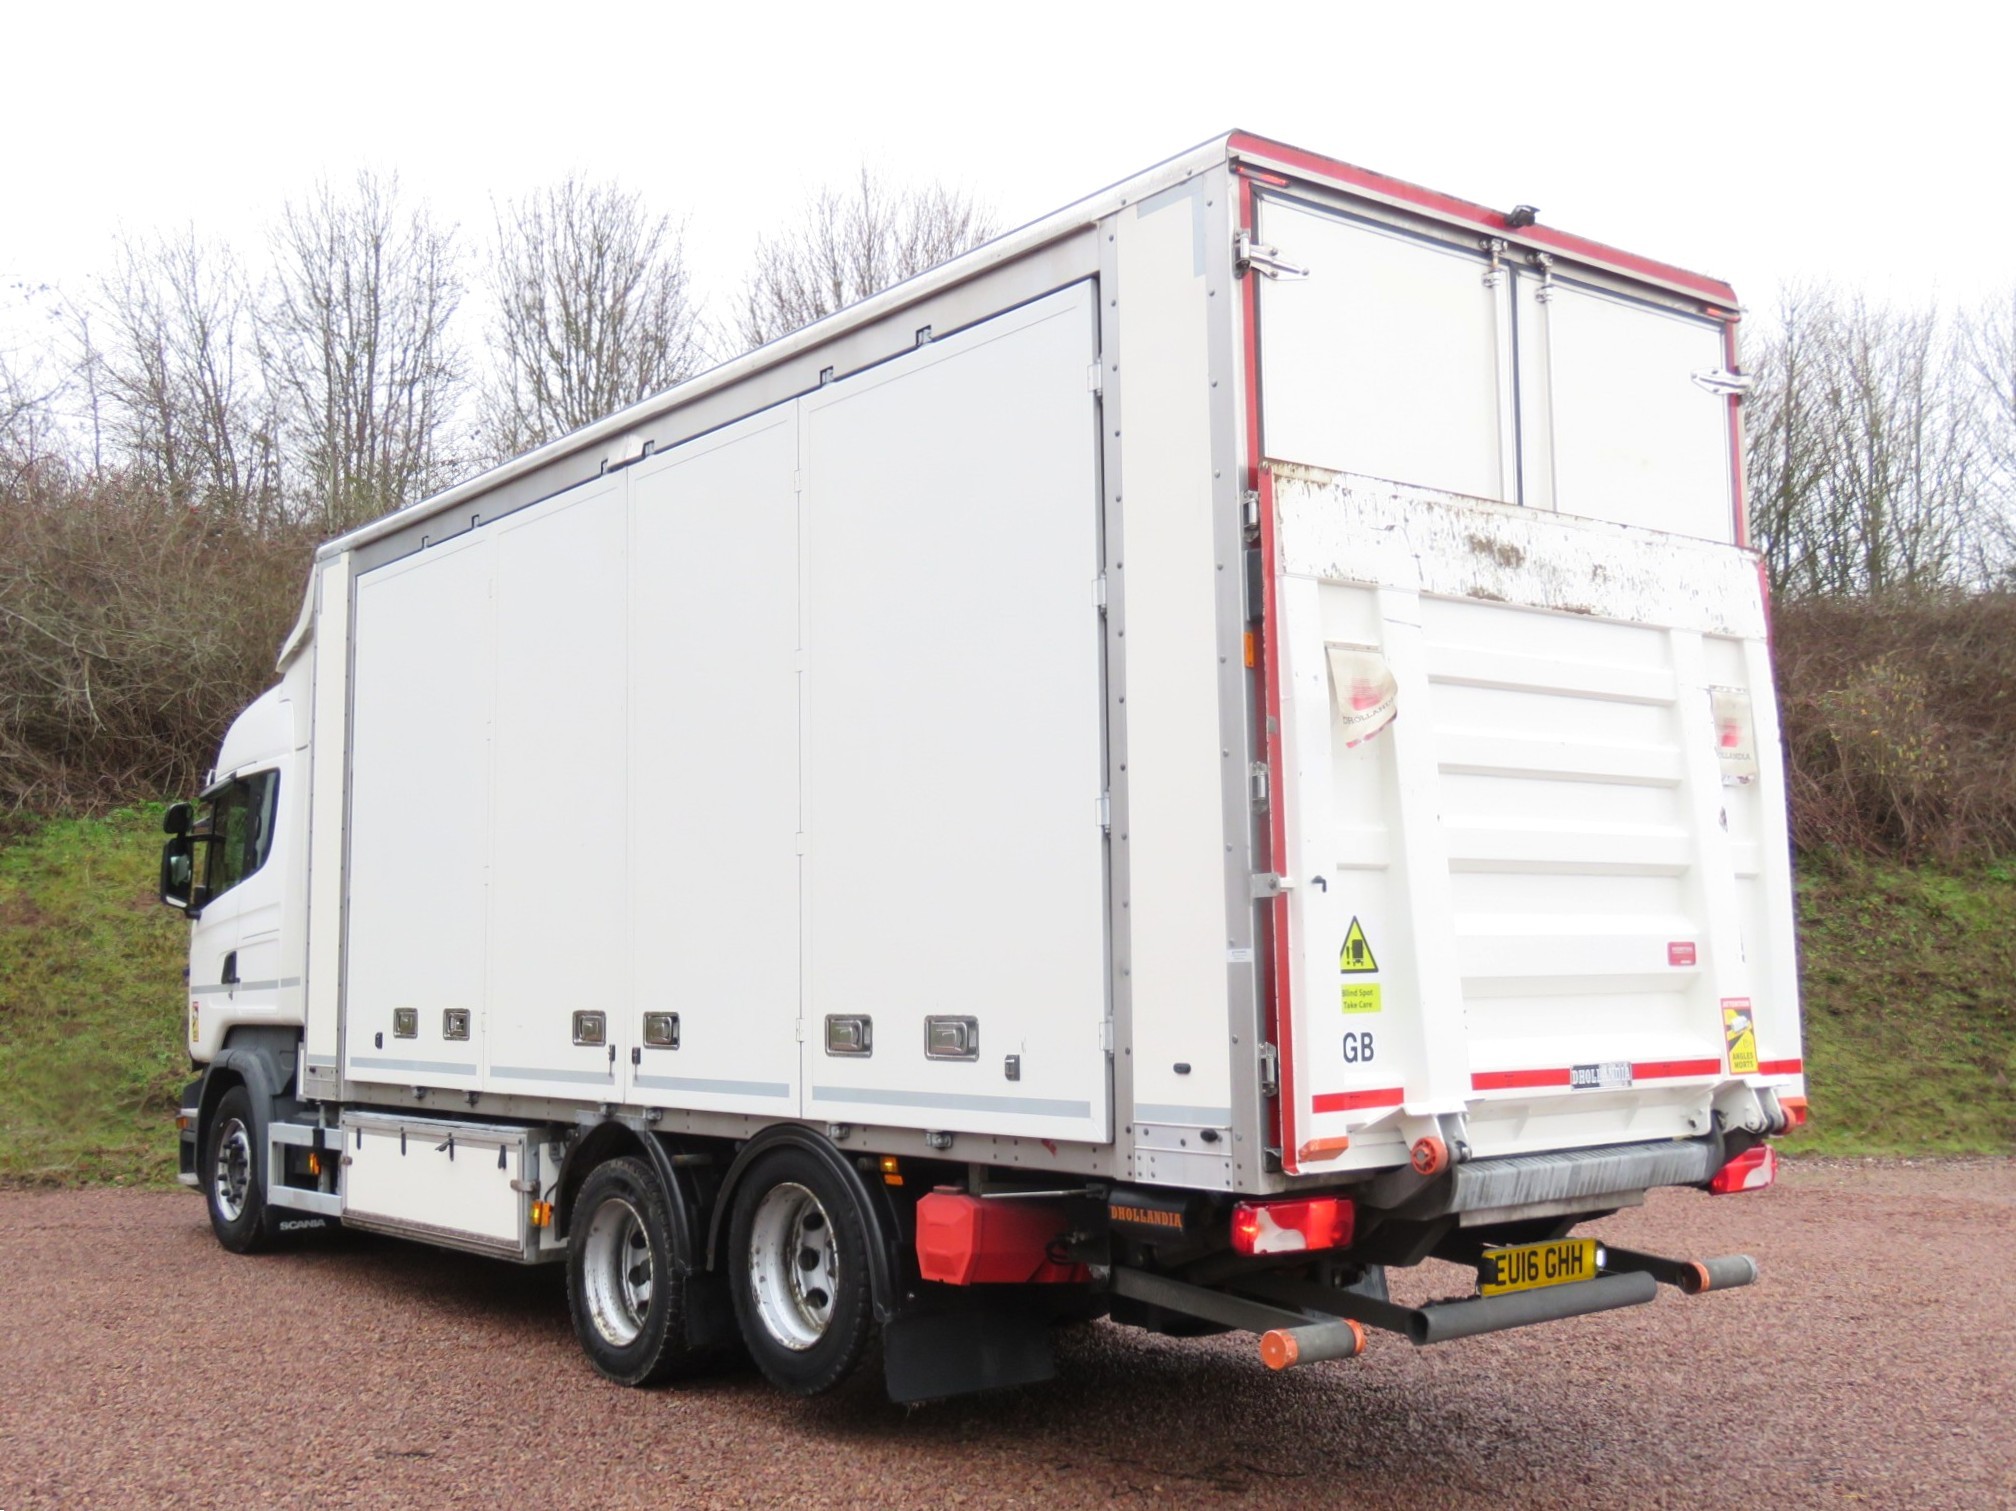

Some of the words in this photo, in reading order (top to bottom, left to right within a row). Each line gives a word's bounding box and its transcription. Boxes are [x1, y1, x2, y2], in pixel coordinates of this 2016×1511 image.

[1342, 988, 1358, 998] Blind
[1359, 988, 1373, 998] Spot
[1343, 1001, 1357, 1009] Take
[1358, 1001, 1373, 1009] Care
[1343, 1031, 1374, 1063] GB
[1733, 1052, 1754, 1061] ANGLES
[1734, 1060, 1754, 1070] MORTS
[1111, 1205, 1183, 1228] DHOLLANDIA
[279, 1218, 326, 1231] SCANIA
[1495, 1248, 1539, 1287] EU16
[1545, 1243, 1583, 1279] GHH
